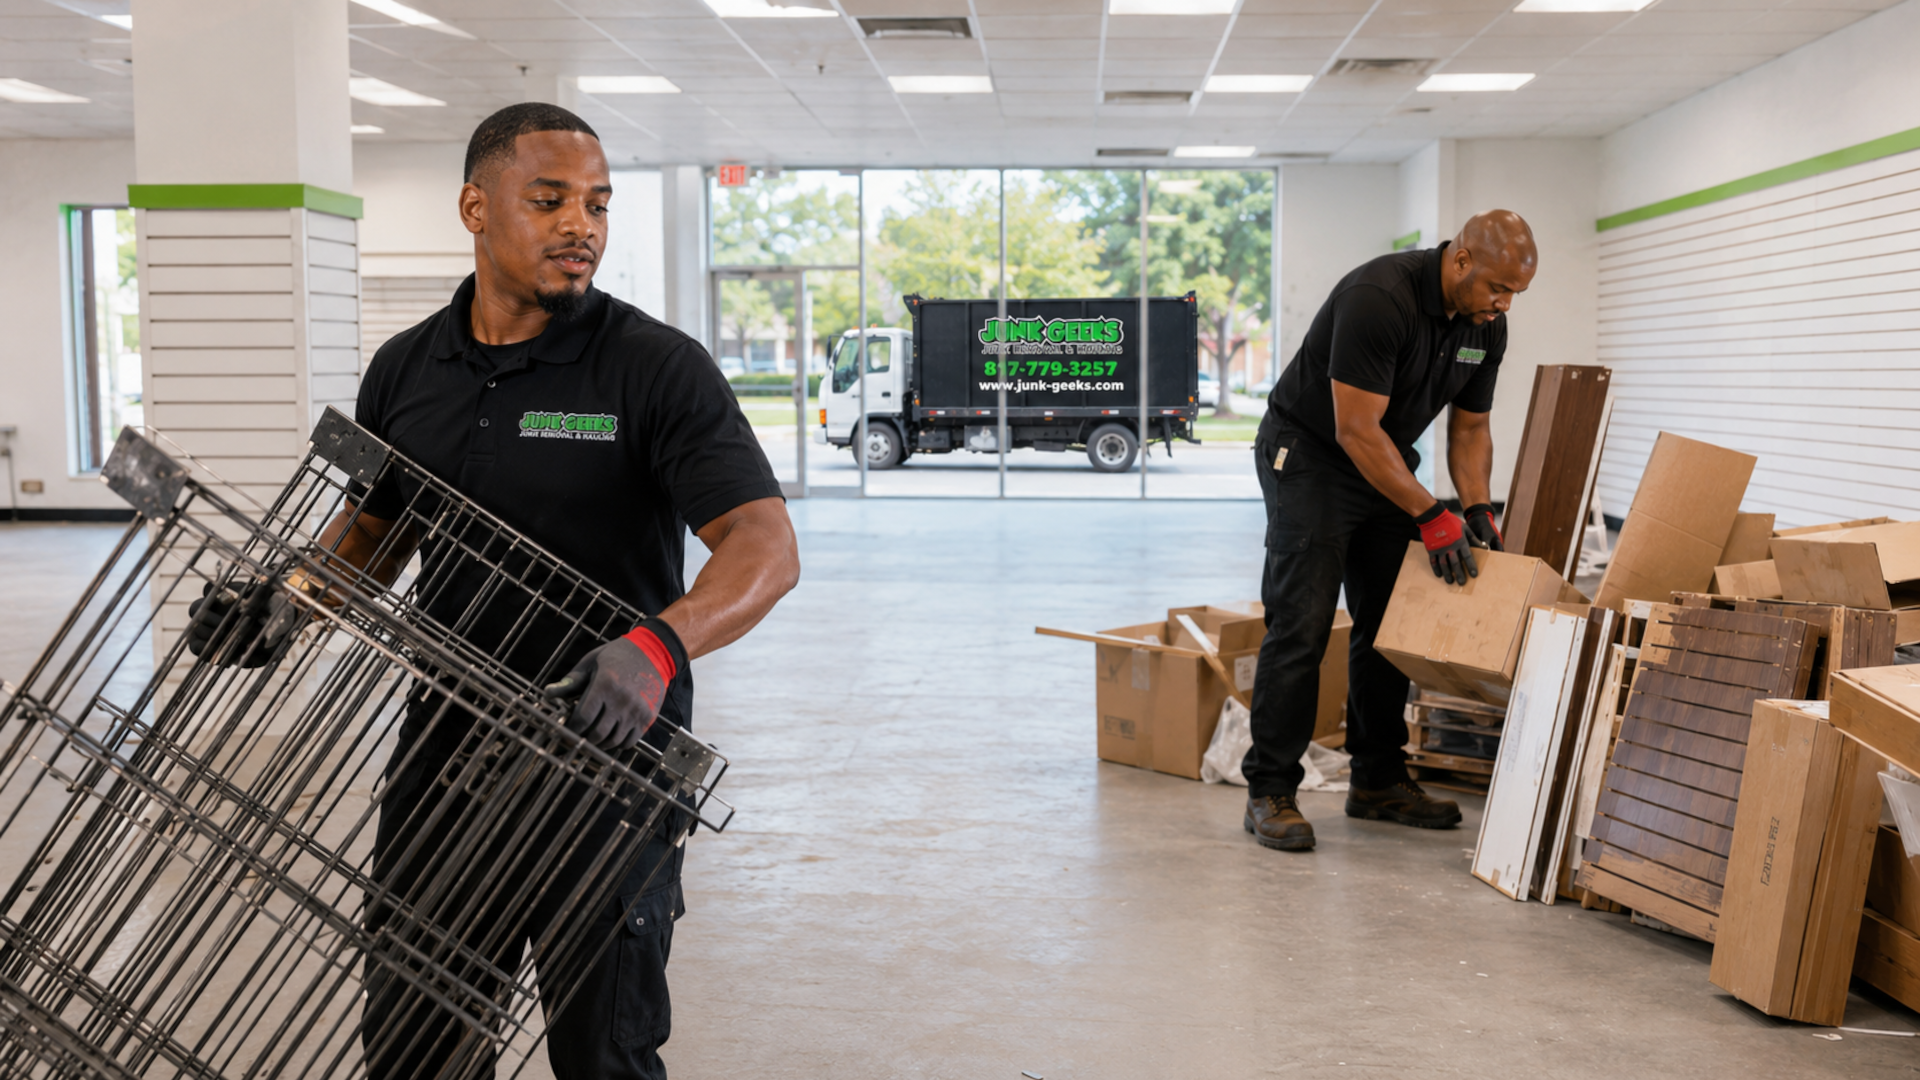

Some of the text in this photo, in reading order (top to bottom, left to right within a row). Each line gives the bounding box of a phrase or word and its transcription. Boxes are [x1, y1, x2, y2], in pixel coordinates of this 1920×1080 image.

[720, 165, 745, 185] EXIT
[980, 319, 1120, 343] JUNK GEEKS
[984, 361, 1118, 376] 817-779-3257
[979, 379, 1124, 393] www.junk-geeks.com
[520, 413, 615, 433] JUNK GEEKS
